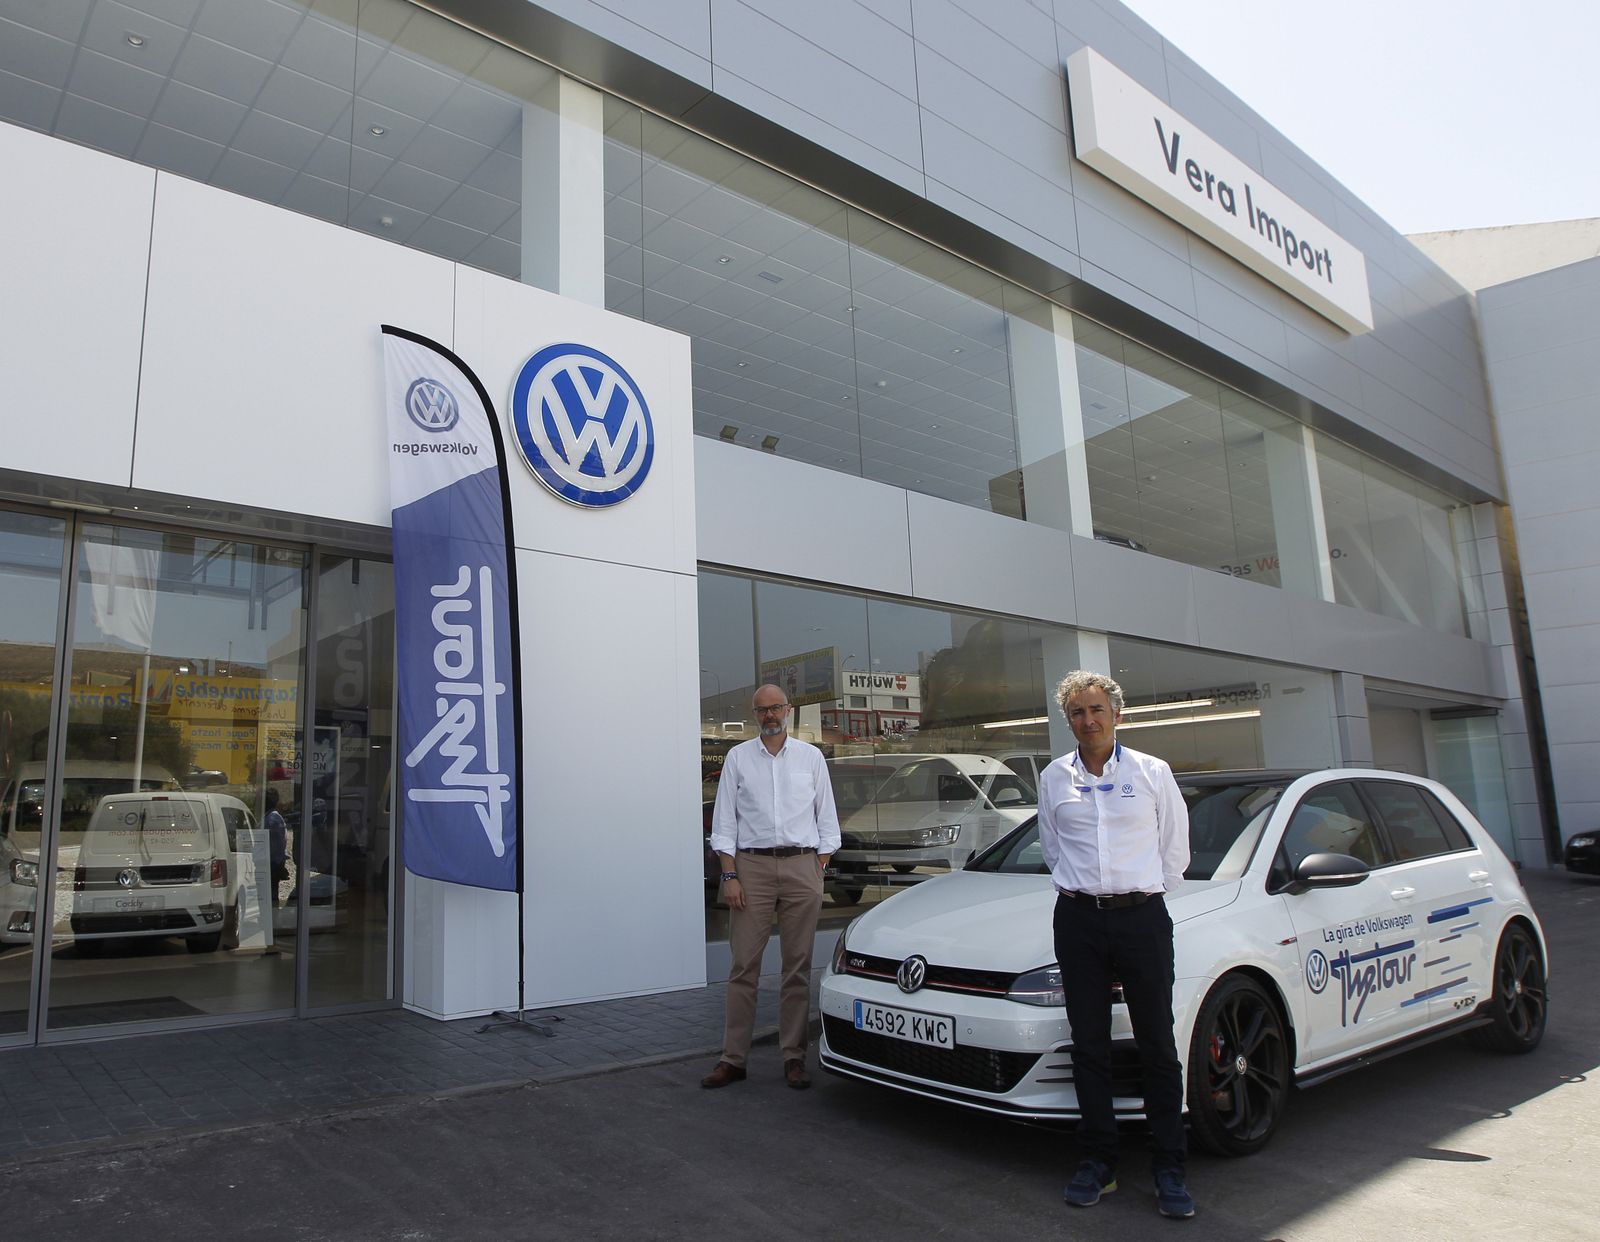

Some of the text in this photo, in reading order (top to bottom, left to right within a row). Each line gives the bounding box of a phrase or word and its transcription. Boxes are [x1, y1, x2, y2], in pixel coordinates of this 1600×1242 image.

[1154, 116, 1334, 284] Vera Import
[1323, 914, 1414, 943] La gira de Volkswagen
[865, 1007, 948, 1044] 4592 KWC
